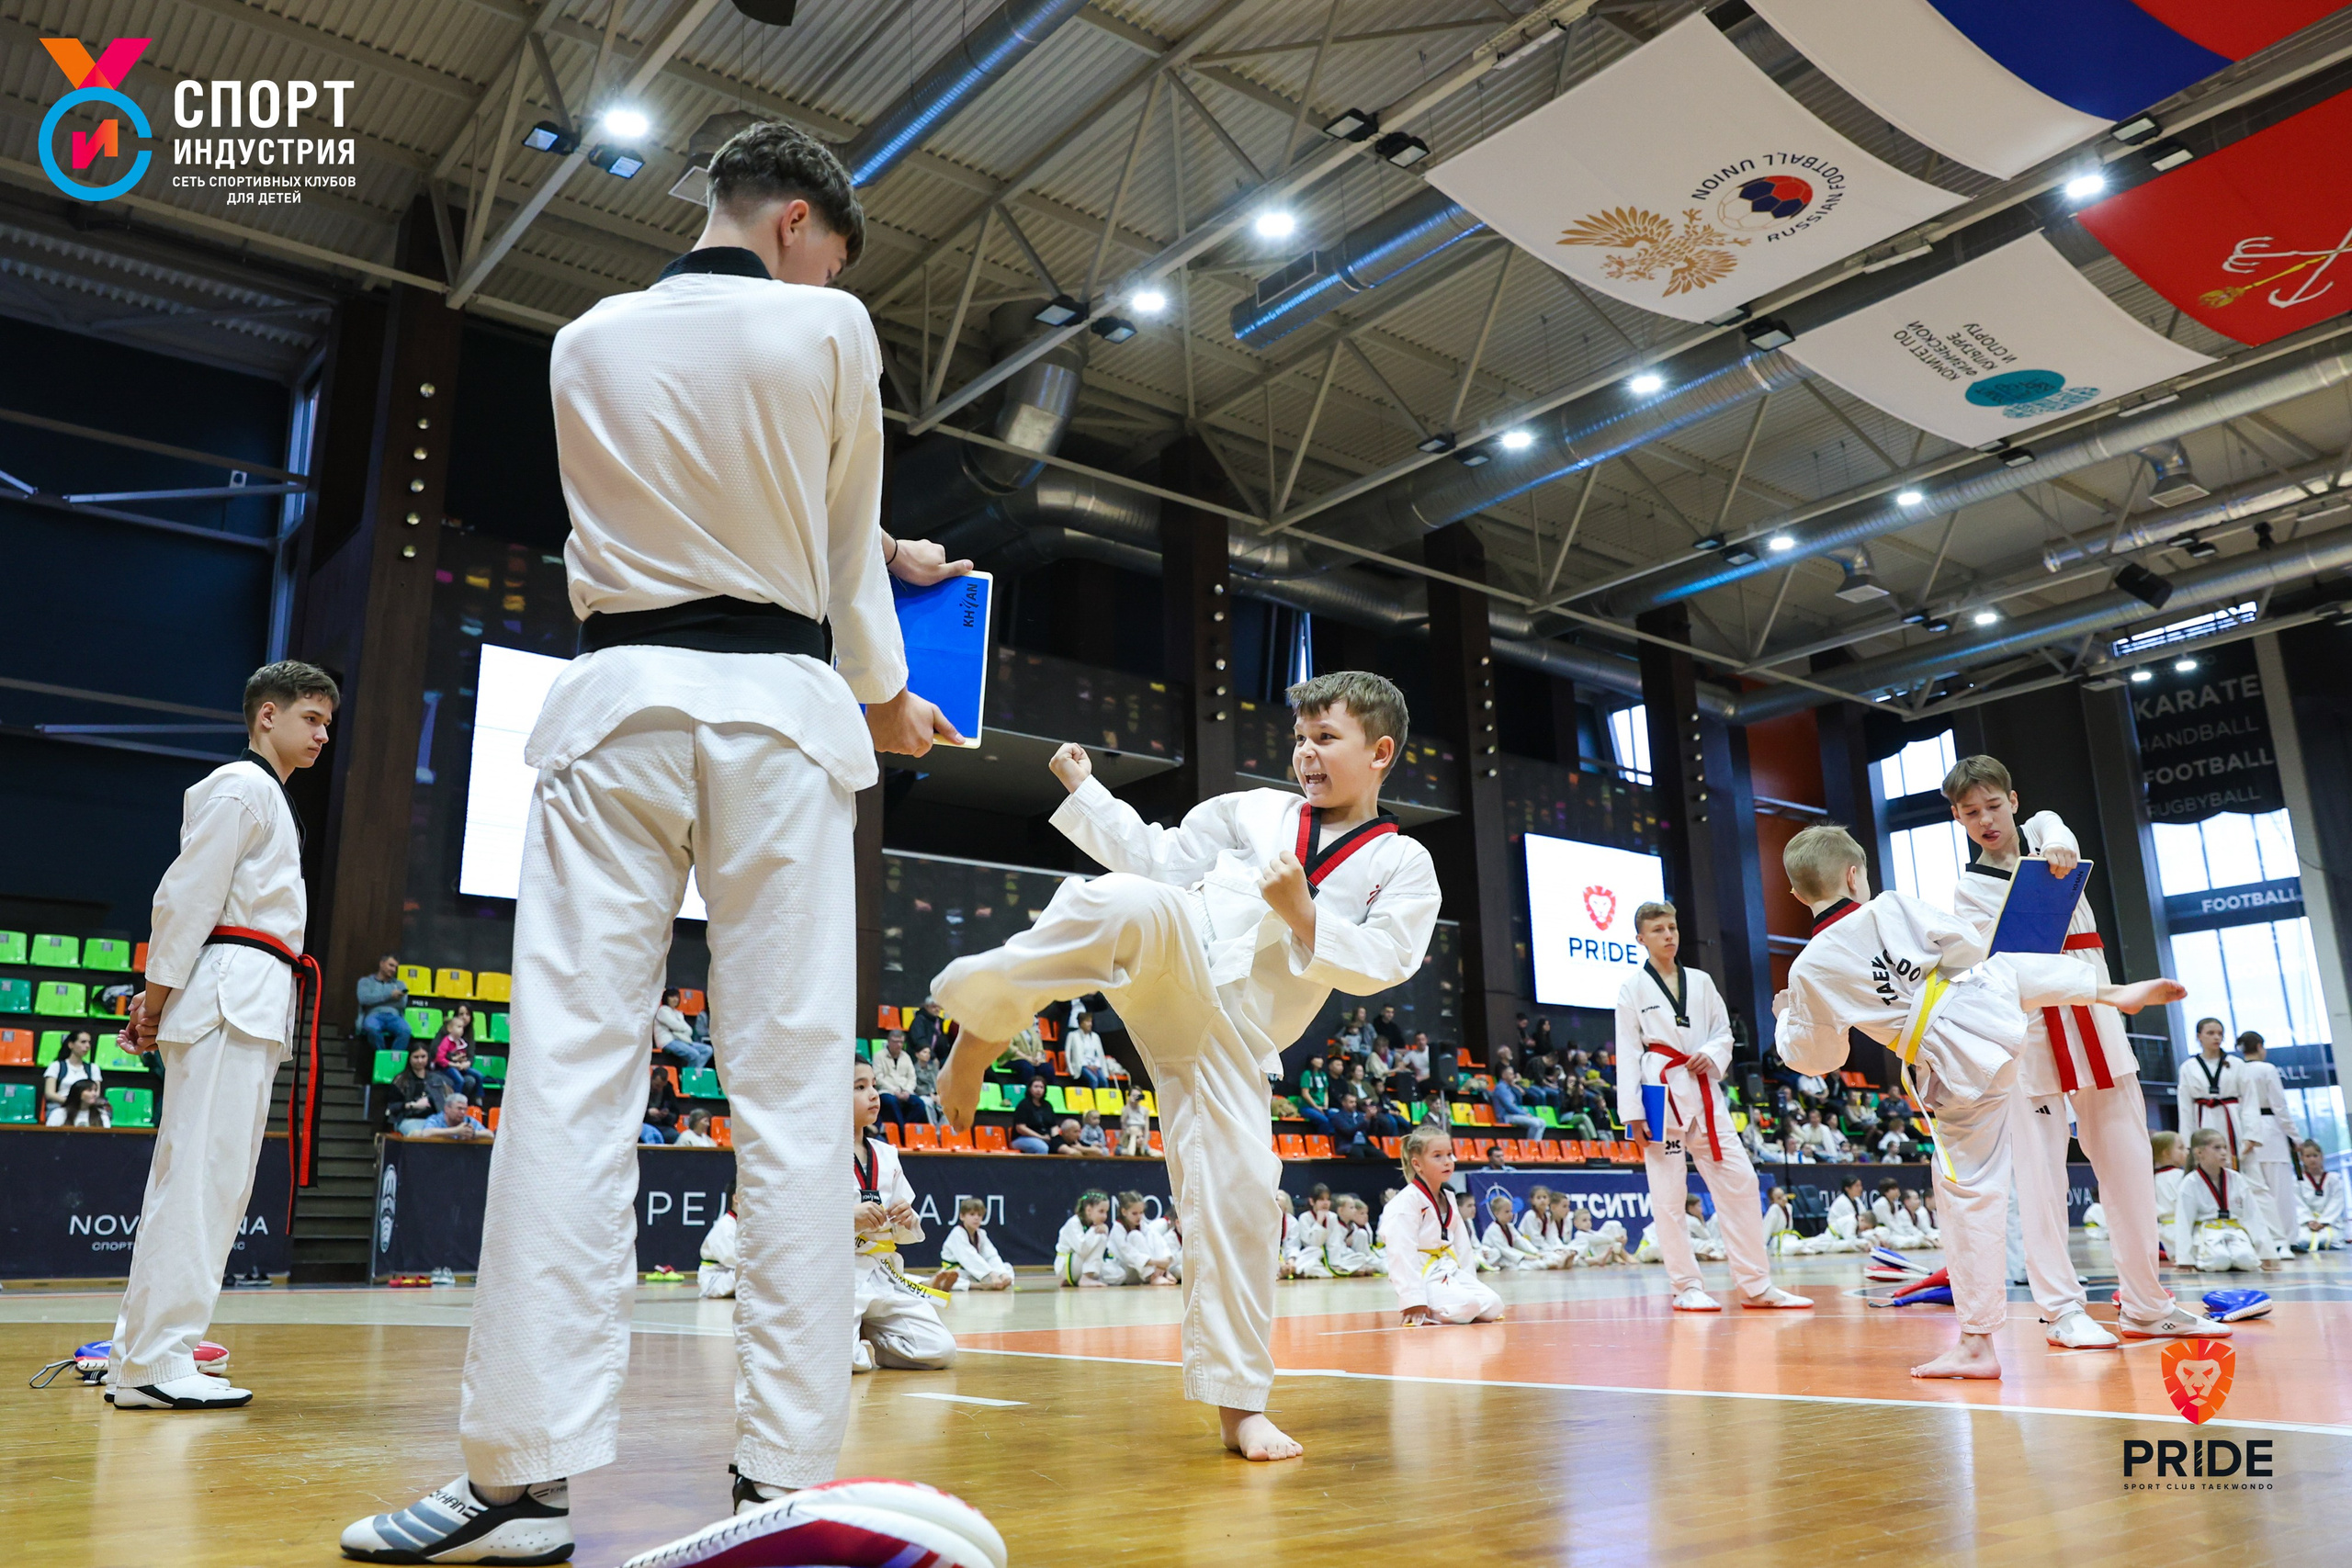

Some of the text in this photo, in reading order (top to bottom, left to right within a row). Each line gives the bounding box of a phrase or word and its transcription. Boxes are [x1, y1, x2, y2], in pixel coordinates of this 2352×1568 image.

[1691, 152, 1847, 243] RUSSIAN FOOTBALL UNION
[1894, 330, 1961, 381] КОМИТЕТ ПО
[1906, 321, 1977, 377] ФИЗИЧЕСКОЙ
[1946, 332, 1998, 371] КУЛЬТУРЕ
[1963, 323, 2018, 364] И СПОРТУ
[2133, 674, 2262, 721] KARATE
[2144, 748, 2275, 785] FOOTBALL
[2201, 888, 2298, 913] FOOTBALL
[1568, 937, 1638, 964] PRIDE
[69, 1214, 140, 1236] NOV
[92, 1242, 133, 1252] СПОРТ
